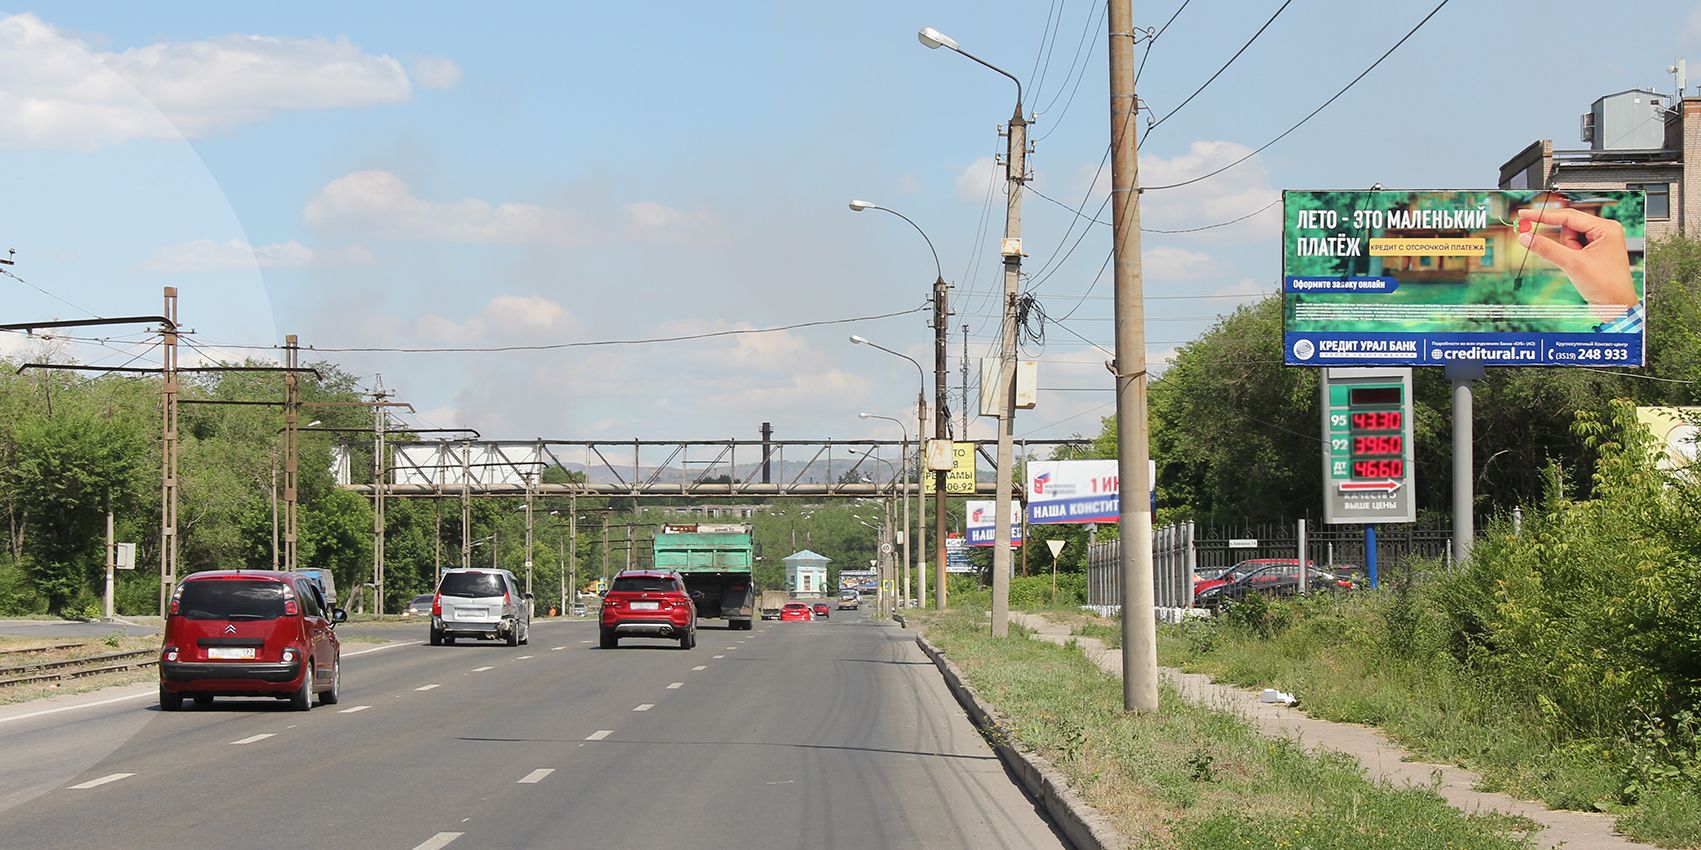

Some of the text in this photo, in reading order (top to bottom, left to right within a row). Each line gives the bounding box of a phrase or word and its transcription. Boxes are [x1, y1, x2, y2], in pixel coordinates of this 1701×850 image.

[1297, 210, 1337, 229] ЛЕТО
[1353, 210, 1383, 229] ЭТО
[1387, 206, 1487, 229] МАЛЕНЬКИЙ
[1297, 234, 1361, 257] ПЛАТЁЖ
[1406, 243, 1450, 251] ОТСРОЧКОЙ
[1293, 279, 1331, 290] Оформите
[1358, 280, 1386, 289] онлайн
[1319, 340, 1417, 353] КРЕДИТ УРАЛ БАНК
[1444, 346, 1536, 360] creditural.ru
[1555, 349, 1628, 360] (3519) 248 933
[1331, 415, 1347, 426] 95
[1332, 439, 1348, 450] 92
[1333, 461, 1347, 470] ДТ
[1091, 478, 1098, 493] 1
[1034, 503, 1067, 519] НАША
[1344, 502, 1397, 510] ВЫШЕ ЦЕНЫ
